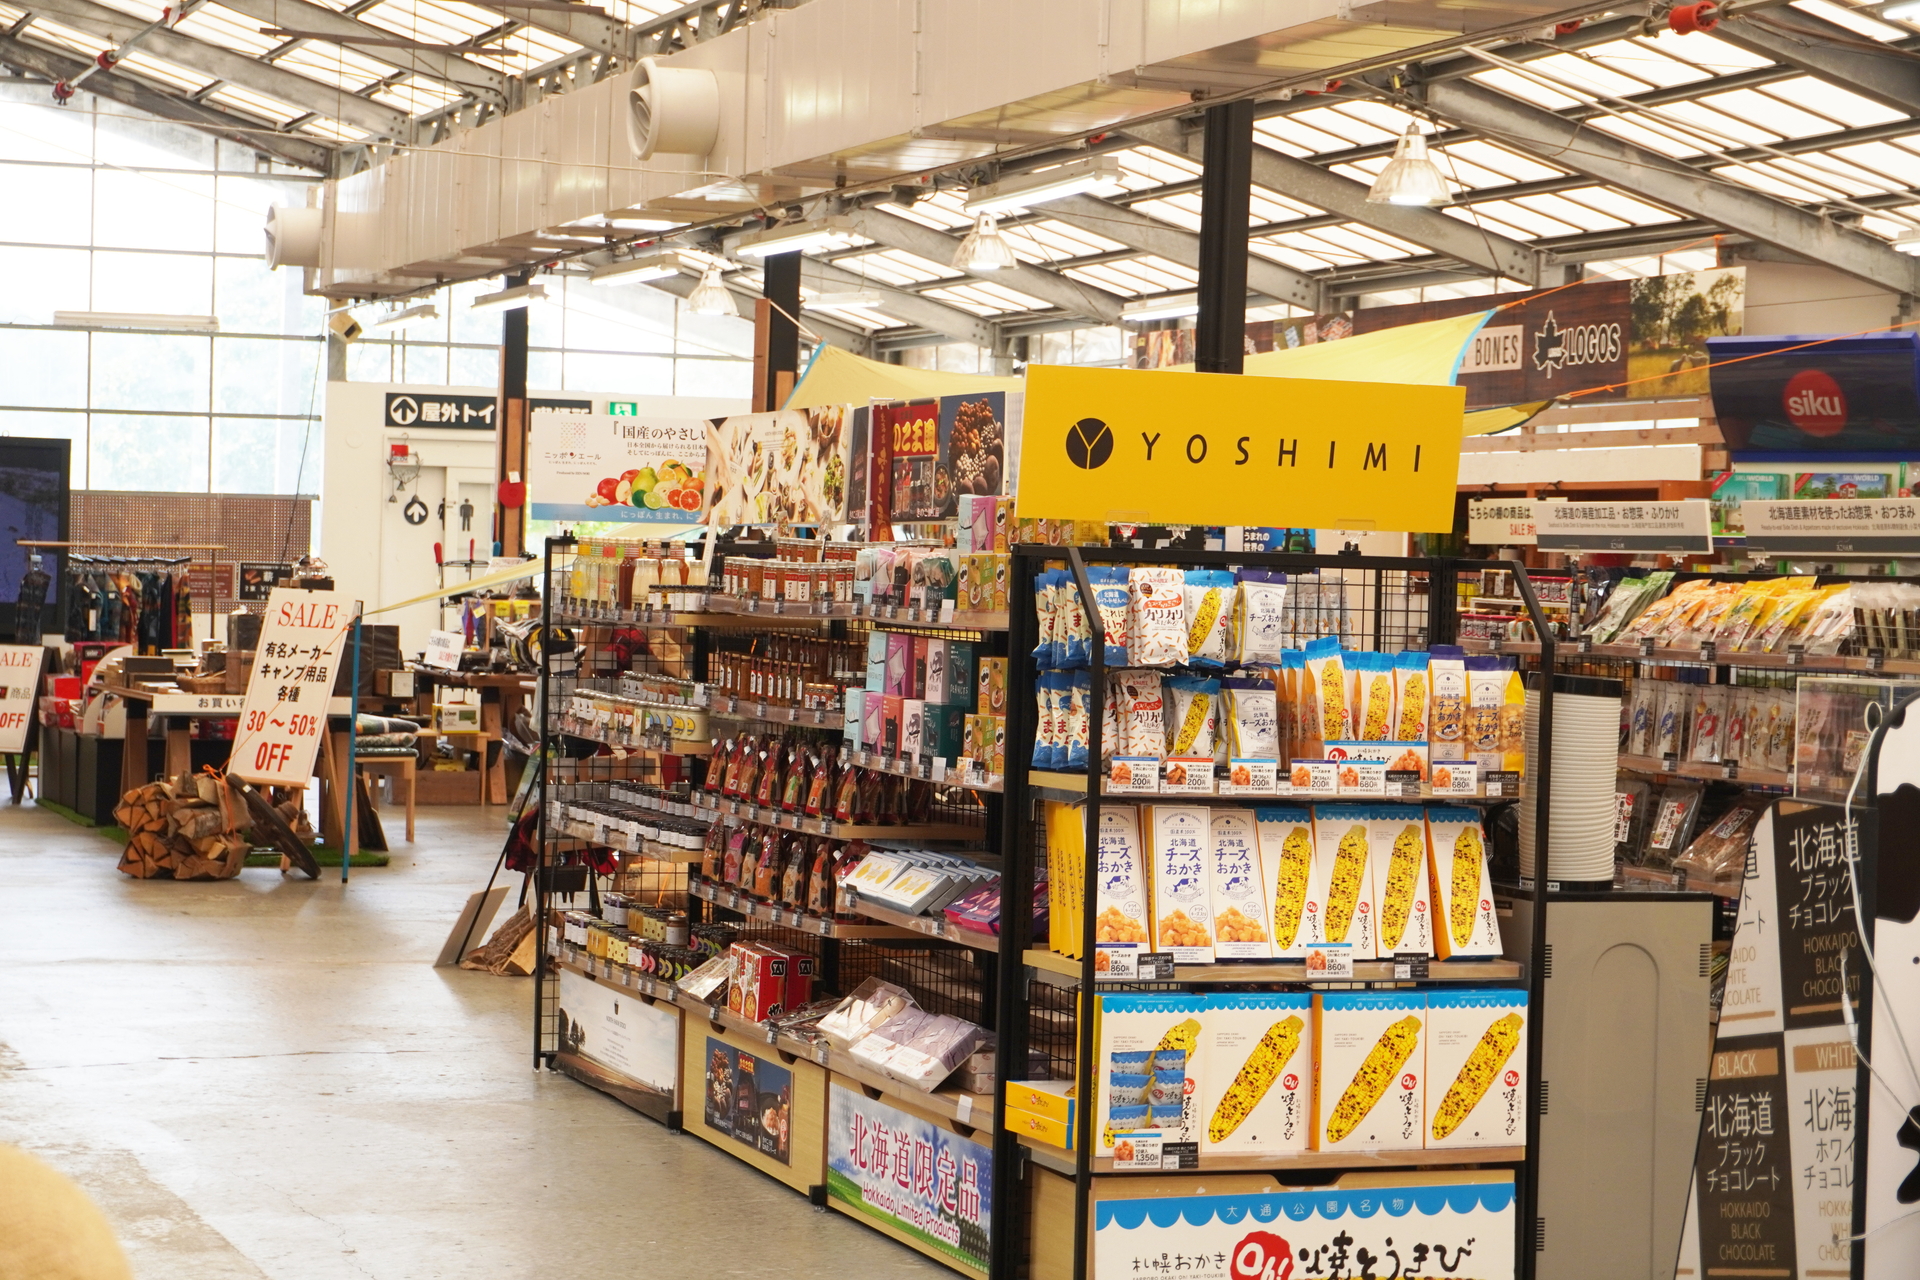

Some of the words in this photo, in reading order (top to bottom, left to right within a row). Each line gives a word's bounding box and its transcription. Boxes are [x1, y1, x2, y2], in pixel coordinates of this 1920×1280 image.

[1475, 334, 1518, 366] BONES
[1566, 323, 1621, 366] LOGOS
[1788, 390, 1842, 416] siku
[544, 452, 602, 461] ニッポンエール
[1141, 431, 1421, 472] YOSHIMI
[1469, 506, 1534, 520] こちらの棚の商品は、
[1243, 532, 1270, 541] うまれの
[1509, 524, 1526, 536] SALE
[1243, 543, 1265, 552] 世界の
[277, 601, 339, 630] SALE
[1073, 613, 1082, 628] ま
[1104, 609, 1124, 618] これに
[1144, 609, 1183, 621] カリカリ
[265, 641, 333, 661] 有名メーカー
[261, 664, 327, 683] キャンプ用品
[10, 688, 31, 700] 商品
[277, 685, 302, 703] 各種
[1438, 701, 1462, 711] チーズ
[1479, 703, 1498, 711] 北海道
[1134, 711, 1164, 723] カリカリ
[1437, 712, 1462, 722] おかき
[1476, 711, 1498, 722] チーズ
[1043, 719, 1053, 734] ま
[1057, 719, 1068, 734] ま
[1475, 723, 1499, 732] おかき
[254, 742, 293, 772] OFF
[1132, 778, 1151, 786] 200円
[1187, 778, 1206, 786] 200円
[1311, 780, 1330, 788] 200円
[1452, 781, 1470, 789] 680円
[1100, 837, 1126, 845] 北海道
[1170, 838, 1197, 847] 北海道
[1218, 839, 1245, 847] 北海道
[1789, 818, 1862, 873] 北海道
[1098, 846, 1132, 860] チーズ
[1165, 848, 1202, 861] チーズ
[1215, 848, 1250, 861] チーズ
[1098, 860, 1133, 873] おかき
[1166, 863, 1202, 875] おかき
[1216, 863, 1252, 874] おかき
[1801, 868, 1852, 901] ブラック
[1307, 914, 1320, 943] 焼とうき
[1803, 931, 1858, 954] HOKKAIDO
[1110, 964, 1130, 972] 860円
[1327, 963, 1346, 971] 860円
[1815, 957, 1848, 974] BLAC
[1816, 1045, 1857, 1069] WHITE
[1718, 1053, 1758, 1077] BLACK
[1707, 1091, 1774, 1138] 北海道
[1803, 1086, 1856, 1133] 北海
[1135, 1153, 1159, 1162] 1,350円
[1717, 1140, 1766, 1167] ブラック
[1816, 1137, 1856, 1163] ホワイ
[850, 1113, 981, 1222] 北海道限定品
[1707, 1165, 1780, 1193] チョコレート
[1803, 1164, 1854, 1190] チョコレ
[863, 1181, 895, 1212] Hokkaido
[896, 1197, 923, 1225] Limited
[925, 1211, 959, 1244] Products
[1226, 1198, 1405, 1218] 大通公園名物
[1720, 1202, 1771, 1219] HOKKAIDO
[1731, 1223, 1761, 1240] BLACK
[1298, 1230, 1475, 1280] 焼とうきび
[1719, 1244, 1776, 1261] CHOCOLATE
[1132, 1251, 1226, 1273] 札幌おかき
[1236, 1242, 1290, 1280] Oh!
